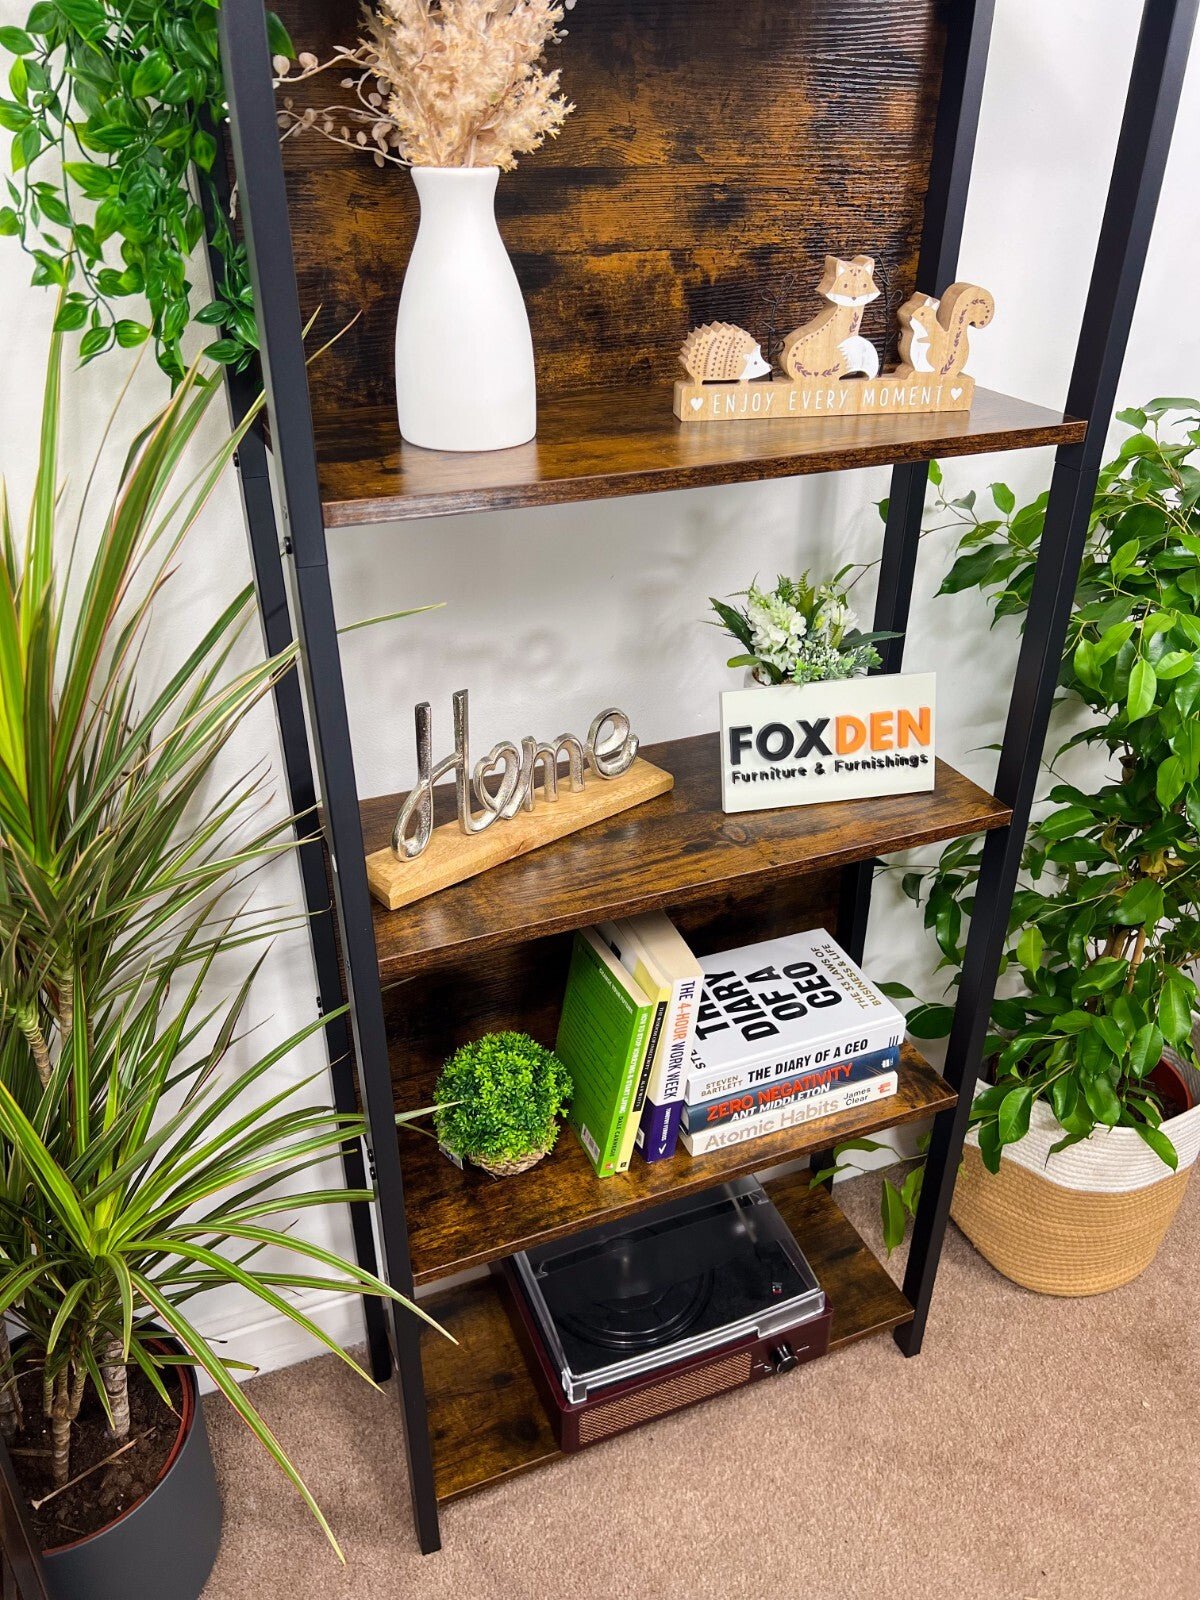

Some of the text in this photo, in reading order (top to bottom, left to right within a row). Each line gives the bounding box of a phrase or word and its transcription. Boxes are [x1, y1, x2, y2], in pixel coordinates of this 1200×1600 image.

[713, 385, 942, 414] ENJOY EVERY MOMENT
[391, 688, 640, 862] Home
[731, 753, 928, 784] Furniture & Furnishings
[822, 944, 840, 960] LIFE
[745, 965, 808, 1021] OF A
[783, 961, 842, 1008] CEO
[811, 947, 868, 1009] THE 33 LAWS OF
[843, 968, 882, 1006] BUSINESS
[705, 970, 780, 1041] DIARY
[663, 980, 695, 1099] THE 4-HOUR WORK WEEK
[748, 1039, 868, 1083] THE DIARY OF A CEO
[701, 1080, 743, 1097] BARTLETT
[706, 1075, 739, 1089] STEVEN
[706, 1062, 854, 1121] ZERO NEGATIVITY
[731, 1083, 830, 1122] ANT MIDDLETON
[843, 1086, 871, 1101] James
[845, 1093, 869, 1107] Clear
[705, 1098, 839, 1151] Atomic Habits
